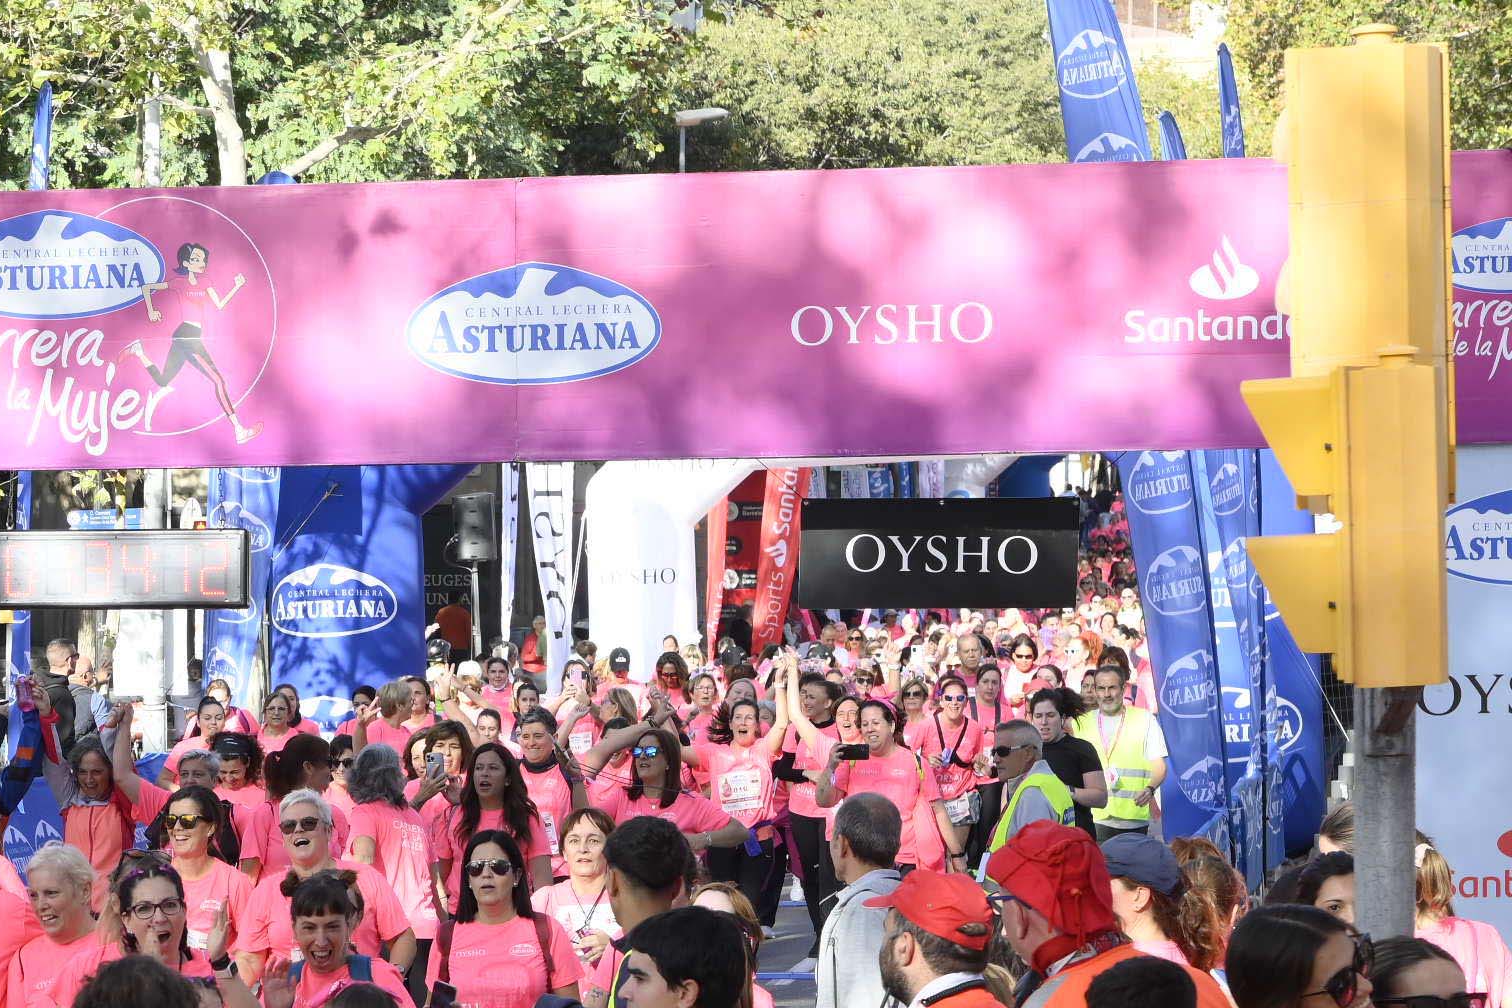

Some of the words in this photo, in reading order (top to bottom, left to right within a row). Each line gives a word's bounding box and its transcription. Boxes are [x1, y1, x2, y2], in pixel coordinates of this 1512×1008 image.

[464, 305, 544, 319] CENTRAL
[552, 303, 632, 316] LECHERA
[790, 302, 993, 346] OYSHO
[1124, 308, 1293, 344] Santand
[429, 310, 641, 354] ASTURIANA
[1475, 328, 1492, 356] la
[7, 374, 30, 411] la
[26, 362, 175, 456] Mujer
[845, 533, 1039, 574] OYSHO
[275, 594, 389, 621] ASTURIANA
[758, 570, 785, 640] Sports
